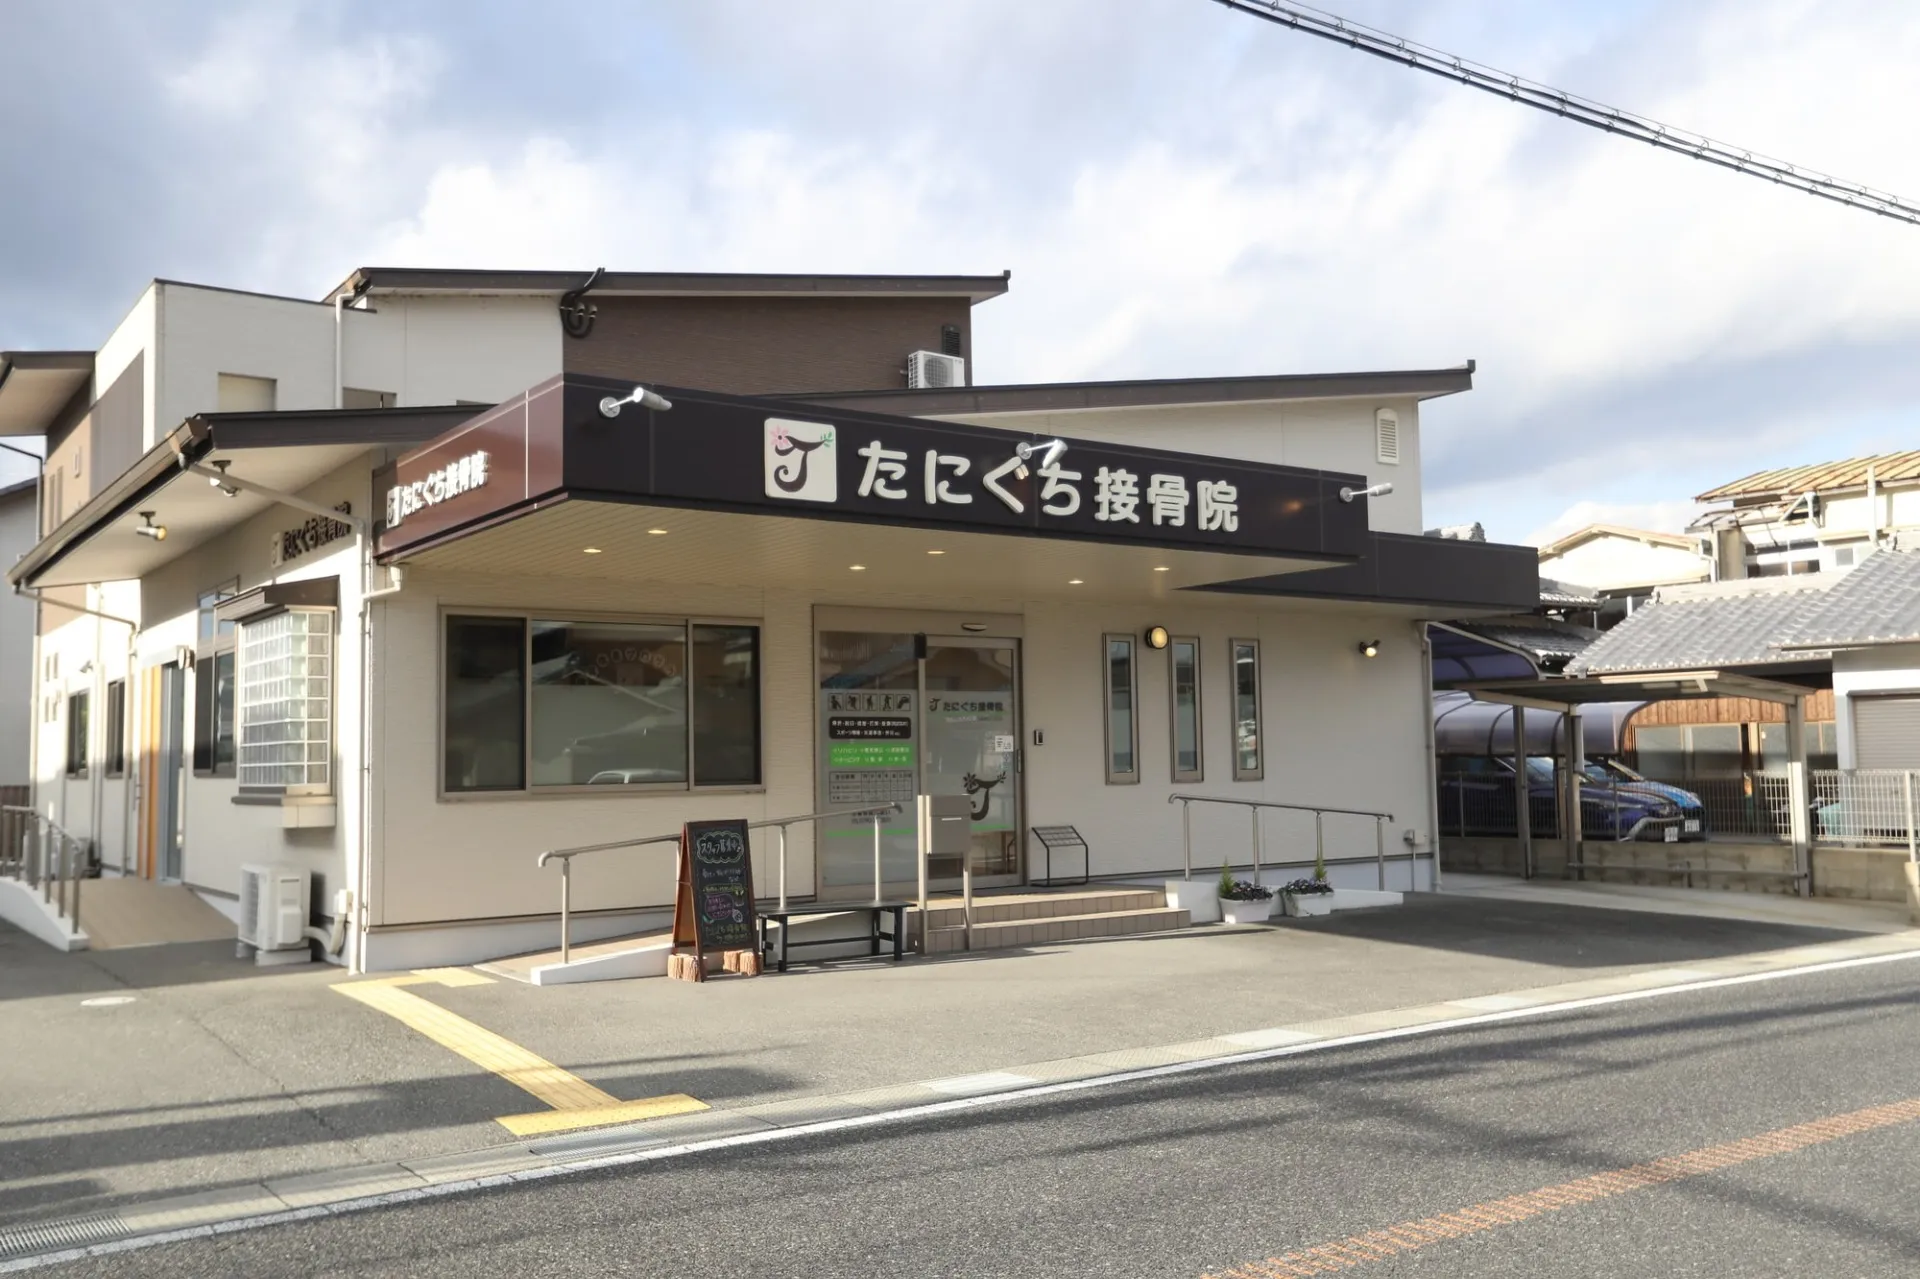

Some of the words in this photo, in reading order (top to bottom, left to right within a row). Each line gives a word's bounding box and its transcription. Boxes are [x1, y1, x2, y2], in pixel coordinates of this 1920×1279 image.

[857, 440, 1241, 533] たにぐち接骨院
